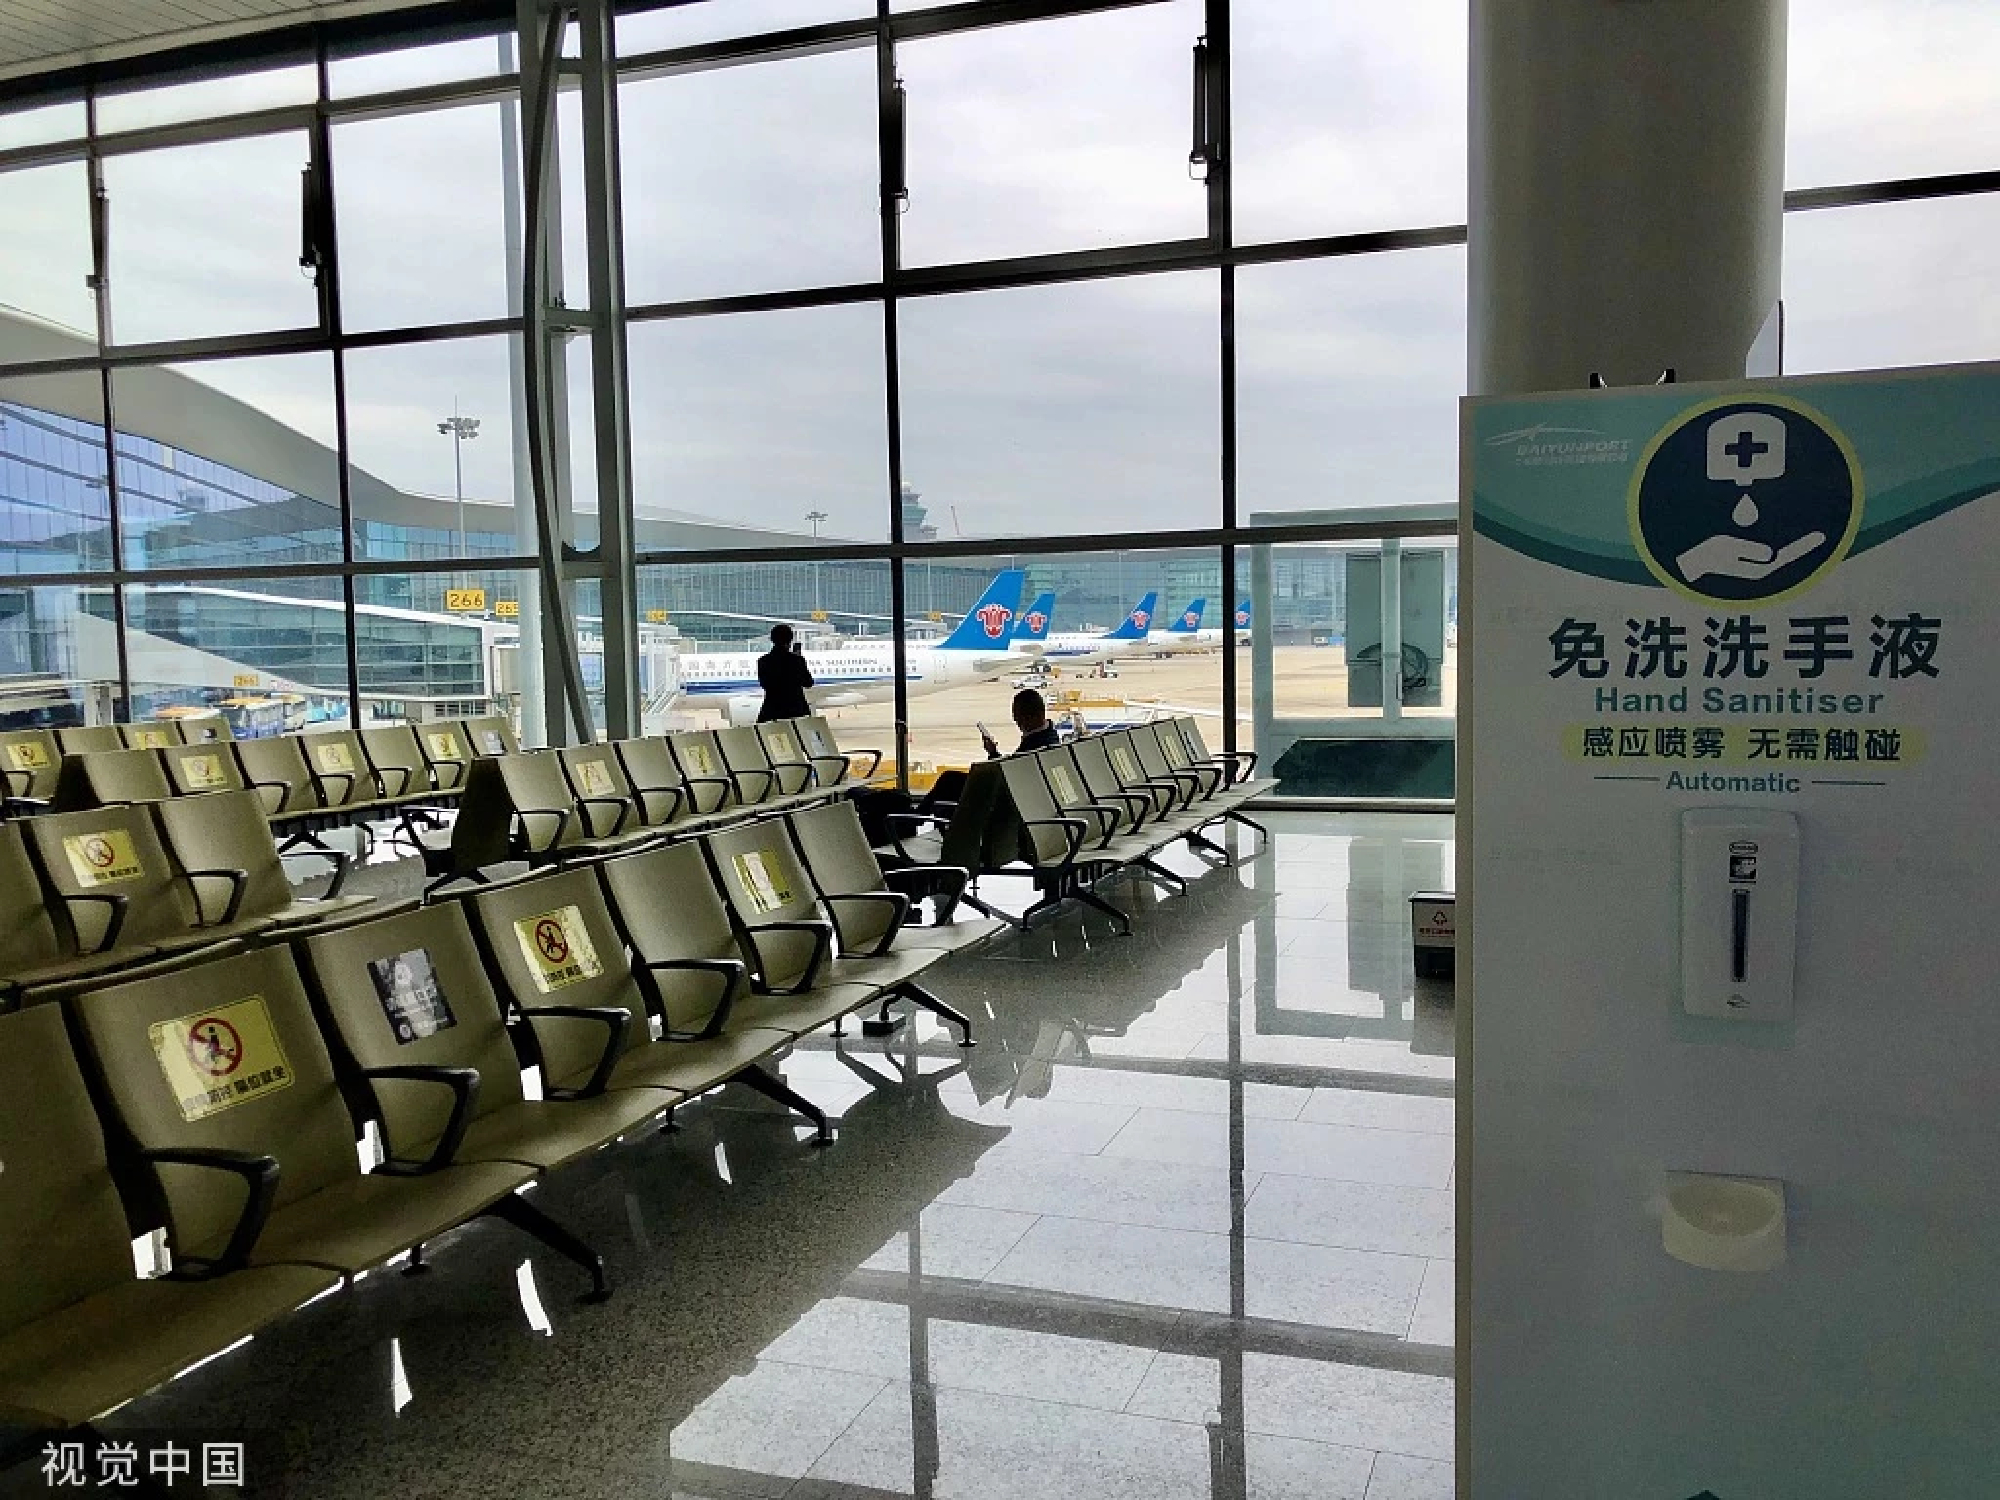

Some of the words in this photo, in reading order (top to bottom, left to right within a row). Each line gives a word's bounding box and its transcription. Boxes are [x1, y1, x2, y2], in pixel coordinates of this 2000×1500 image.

[450, 593, 482, 608] 266
[1548, 612, 1942, 681] 免洗洗手液
[1596, 687, 1688, 714] Hand
[1702, 687, 1885, 714] Sanitiser
[1583, 727, 1726, 760] 感应喷雾
[1747, 727, 1901, 762] 无需触碰
[1666, 771, 1801, 793] Automatic
